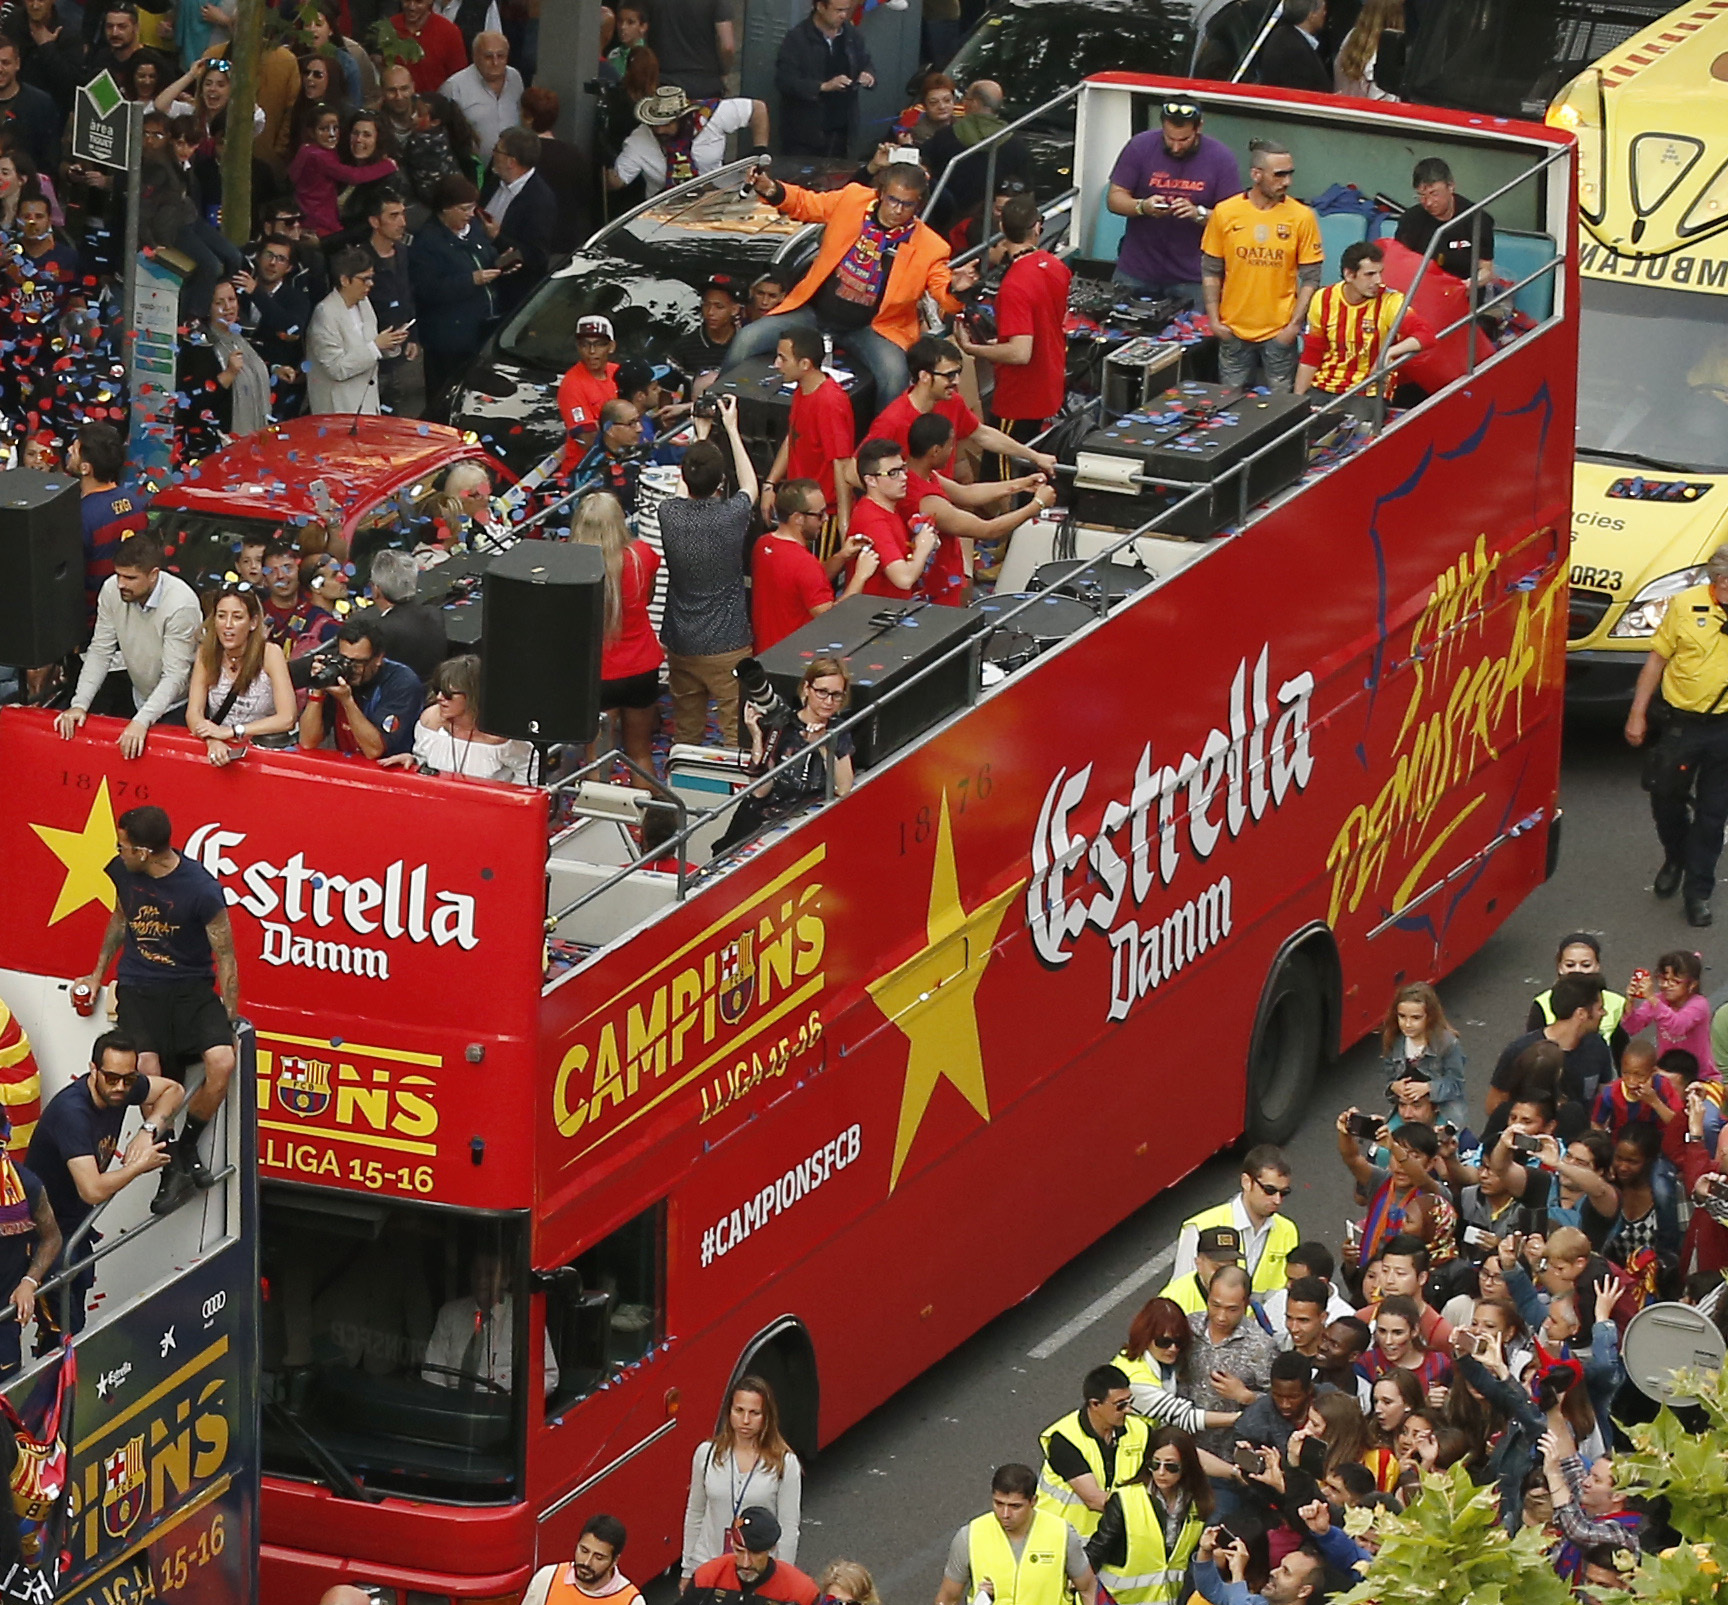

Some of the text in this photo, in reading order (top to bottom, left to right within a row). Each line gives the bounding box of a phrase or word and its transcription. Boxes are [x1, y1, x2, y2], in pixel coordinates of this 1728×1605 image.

[1236, 246, 1285, 260] QATAR
[1027, 641, 1317, 966] Estrella
[181, 822, 480, 961] Estrella
[258, 918, 390, 981] Damm
[1108, 875, 1233, 1022] Damm
[257, 1137, 435, 1193] LIGA 15-16
[700, 1122, 862, 1269] #CAMPIONSFCB
[159, 1513, 225, 1596] 15-16
